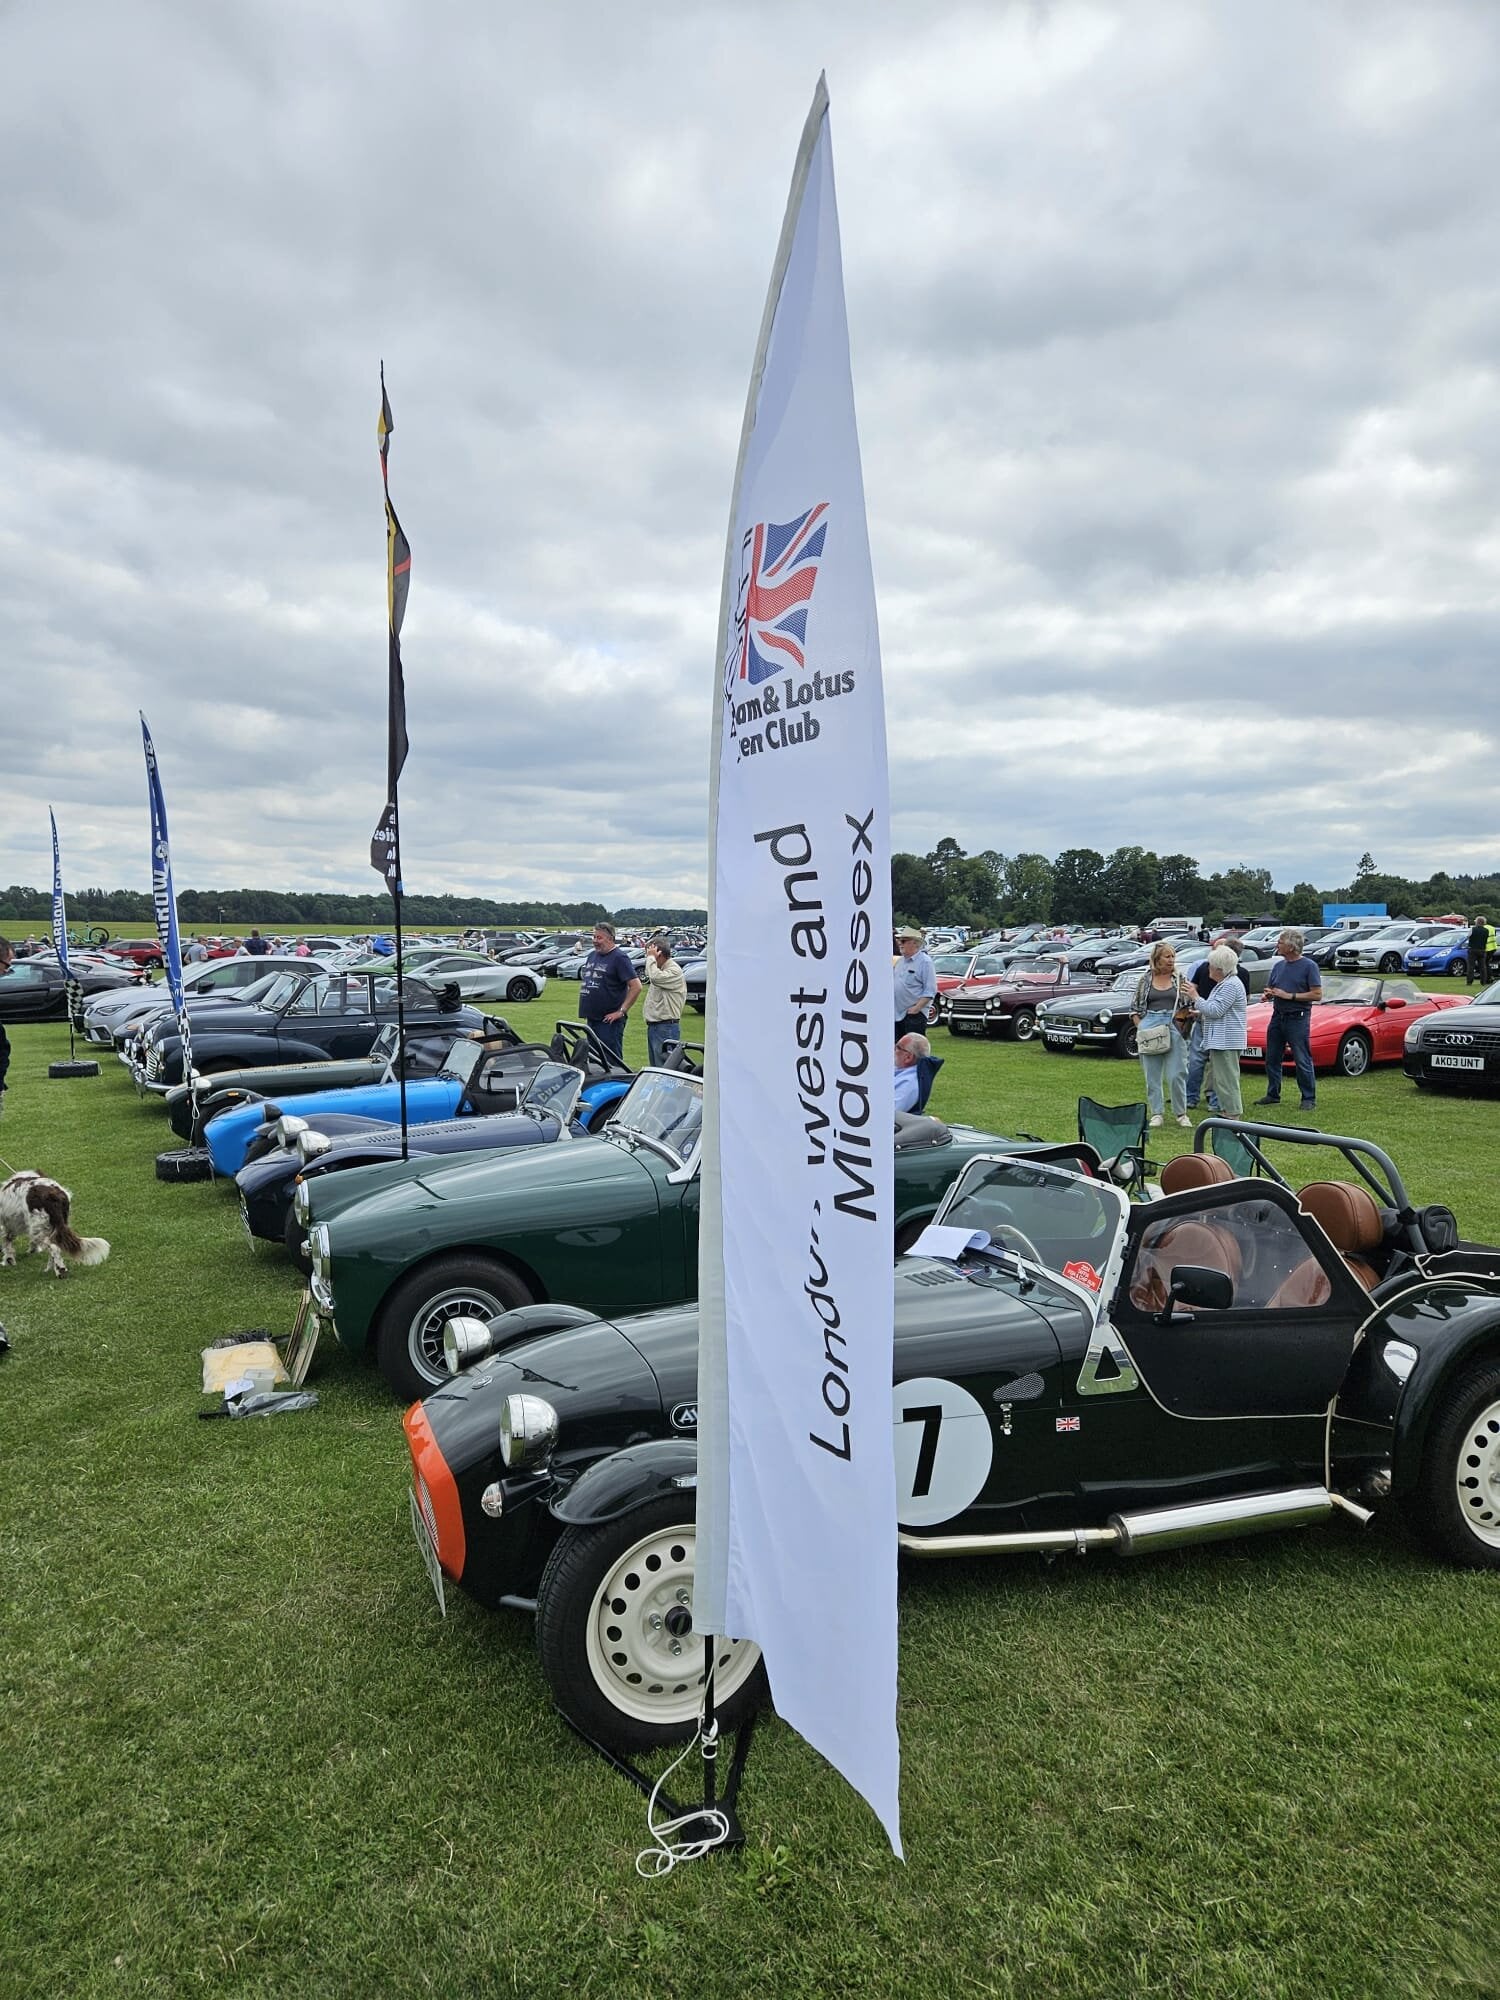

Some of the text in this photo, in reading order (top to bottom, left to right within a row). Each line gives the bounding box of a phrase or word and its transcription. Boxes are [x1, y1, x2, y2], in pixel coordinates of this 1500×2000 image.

[783, 668, 855, 710] Lotus
[765, 711, 820, 751] Club
[753, 823, 828, 960] and
[1435, 1056, 1481, 1068] AK03 UNT
[902, 1404, 943, 1498] 7
